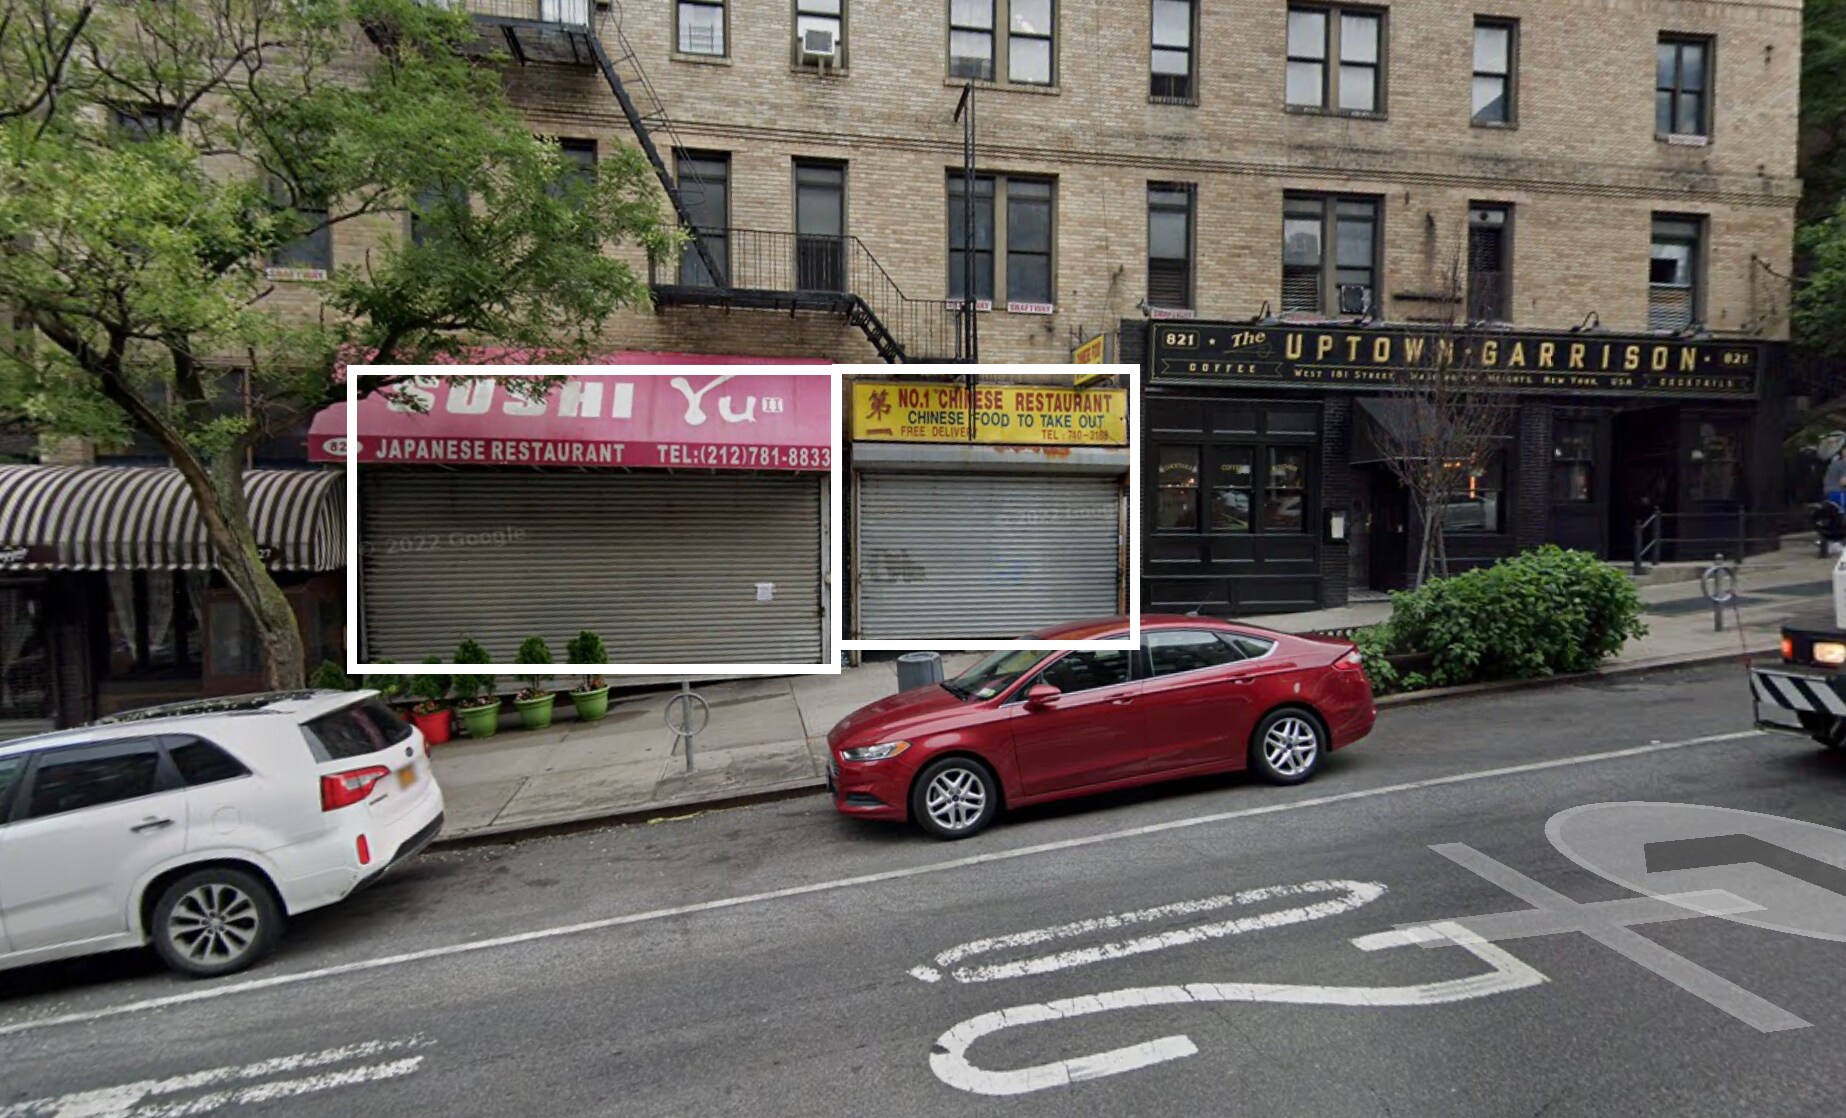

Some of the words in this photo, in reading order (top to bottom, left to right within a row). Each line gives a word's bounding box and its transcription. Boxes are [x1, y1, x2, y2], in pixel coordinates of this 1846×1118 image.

[1166, 333, 1195, 346] 821
[1231, 331, 1266, 348] The
[1285, 333, 1455, 364] UPTOWN
[1482, 340, 1697, 372] GARRISON
[1188, 362, 1256, 373] COFFEE
[670, 375, 757, 425] Yu
[899, 388, 929, 409] NO.1
[938, 389, 1003, 411] CHINESE
[1015, 392, 1112, 413] RESTAURANT
[908, 409, 964, 426] CHINESE
[972, 411, 1010, 427] FOOD
[1017, 413, 1034, 428] TO
[1041, 414, 1072, 429] TAKE
[1078, 415, 1105, 429] OUT
[901, 425, 926, 438] FREE
[932, 427, 977, 440] DELIVE
[376, 438, 485, 460] JAPANESE
[491, 441, 625, 463] RESTAURANT
